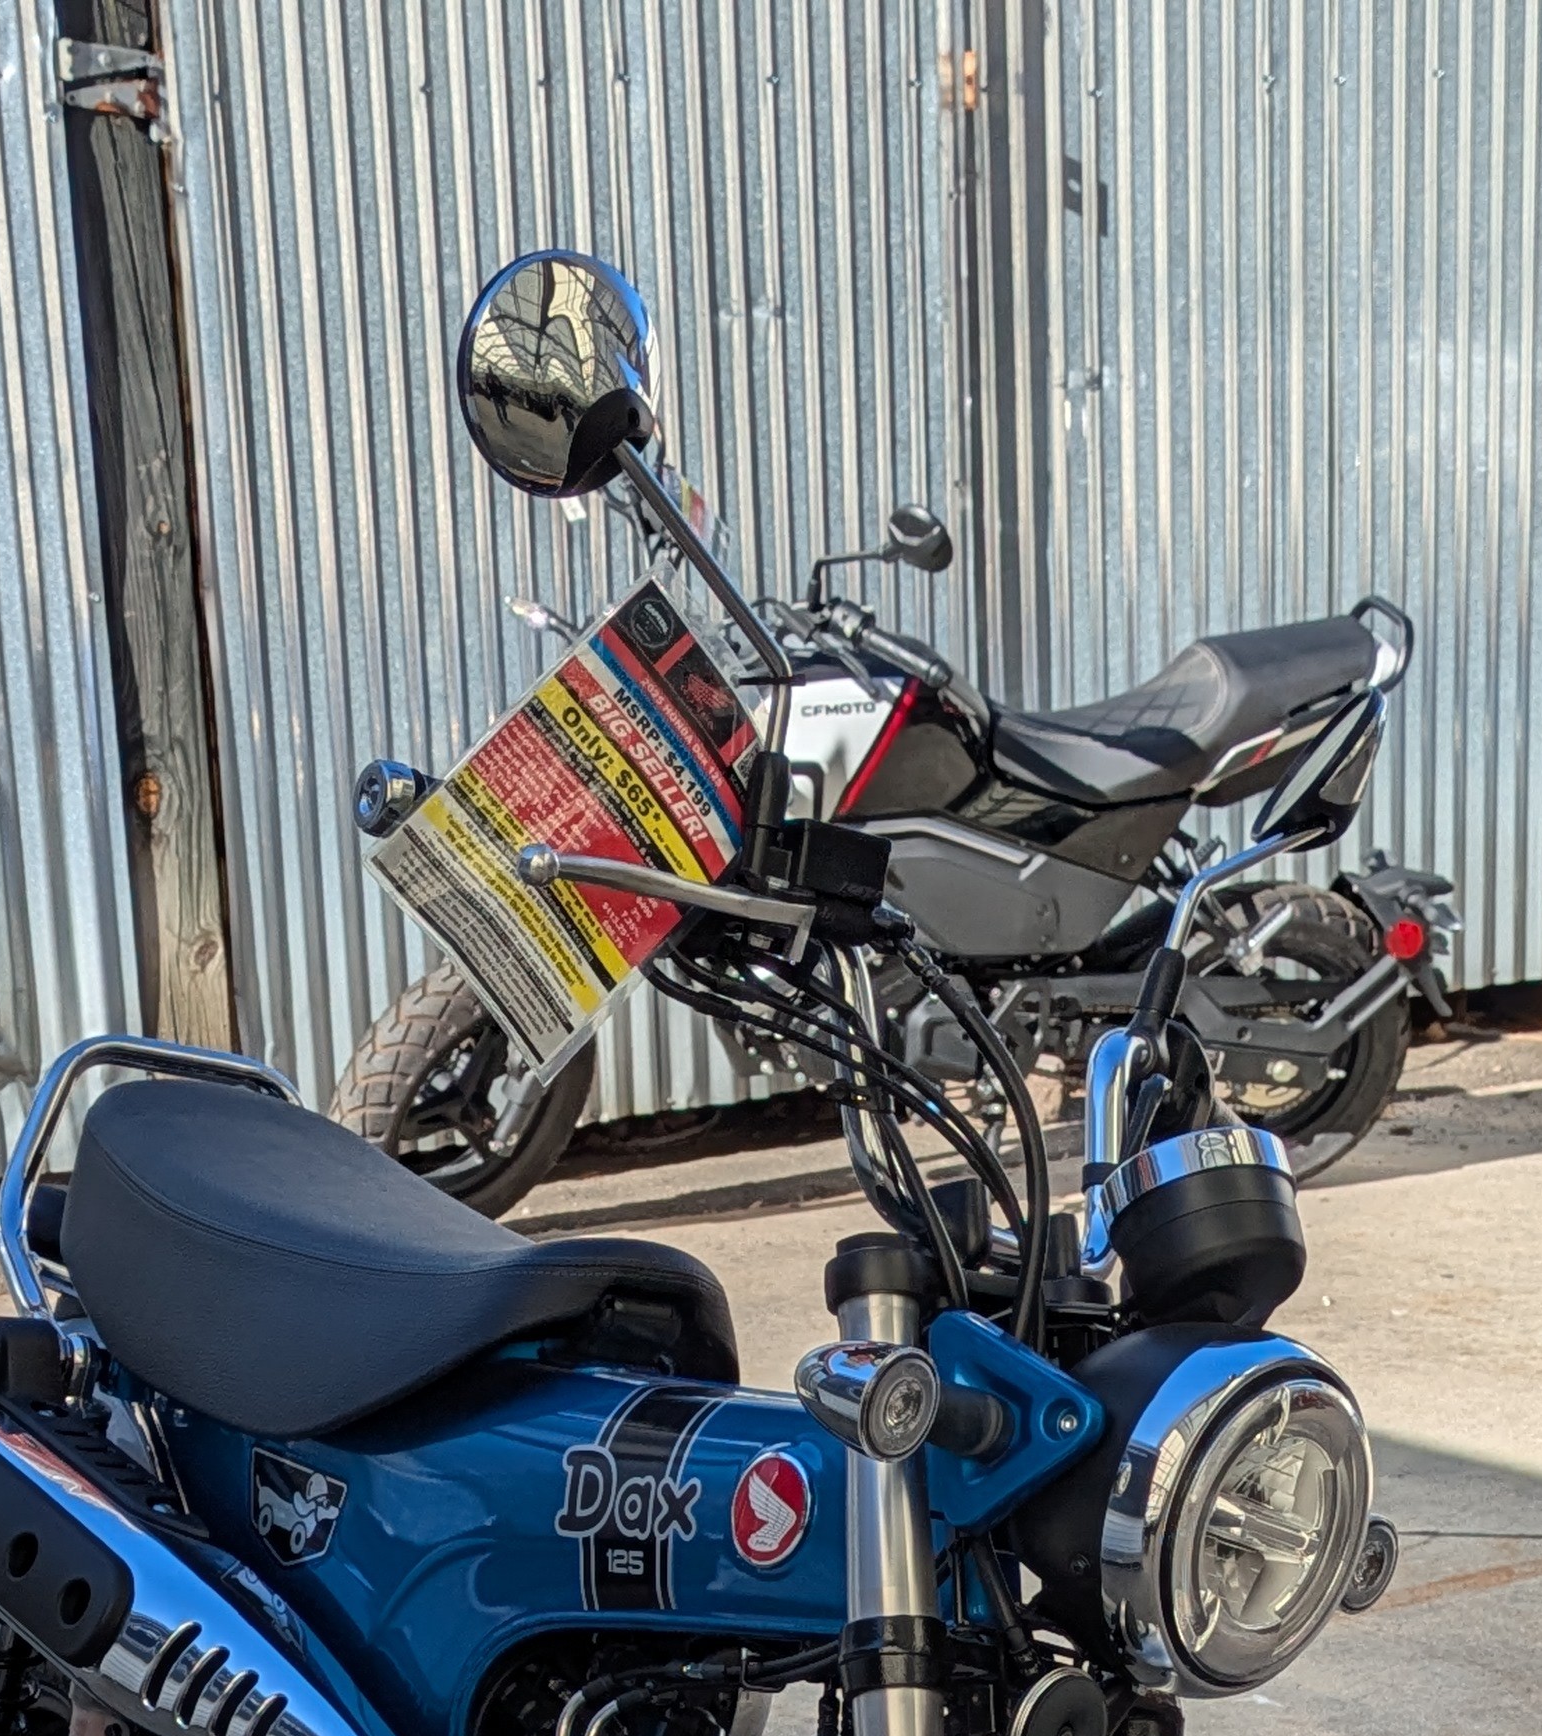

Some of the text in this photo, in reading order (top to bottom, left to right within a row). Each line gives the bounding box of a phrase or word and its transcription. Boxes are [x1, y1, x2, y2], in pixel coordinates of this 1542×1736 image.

[559, 703, 616, 771] Only:
[612, 686, 665, 751] MSRP:
[801, 702, 876, 717] CFMOTO
[587, 687, 634, 742] BIG
[627, 736, 708, 847] SELLER!
[661, 702, 694, 745] HONDA
[707, 765, 723, 788] 125
[554, 1443, 702, 1542] Dax
[606, 1548, 644, 1575] 125
